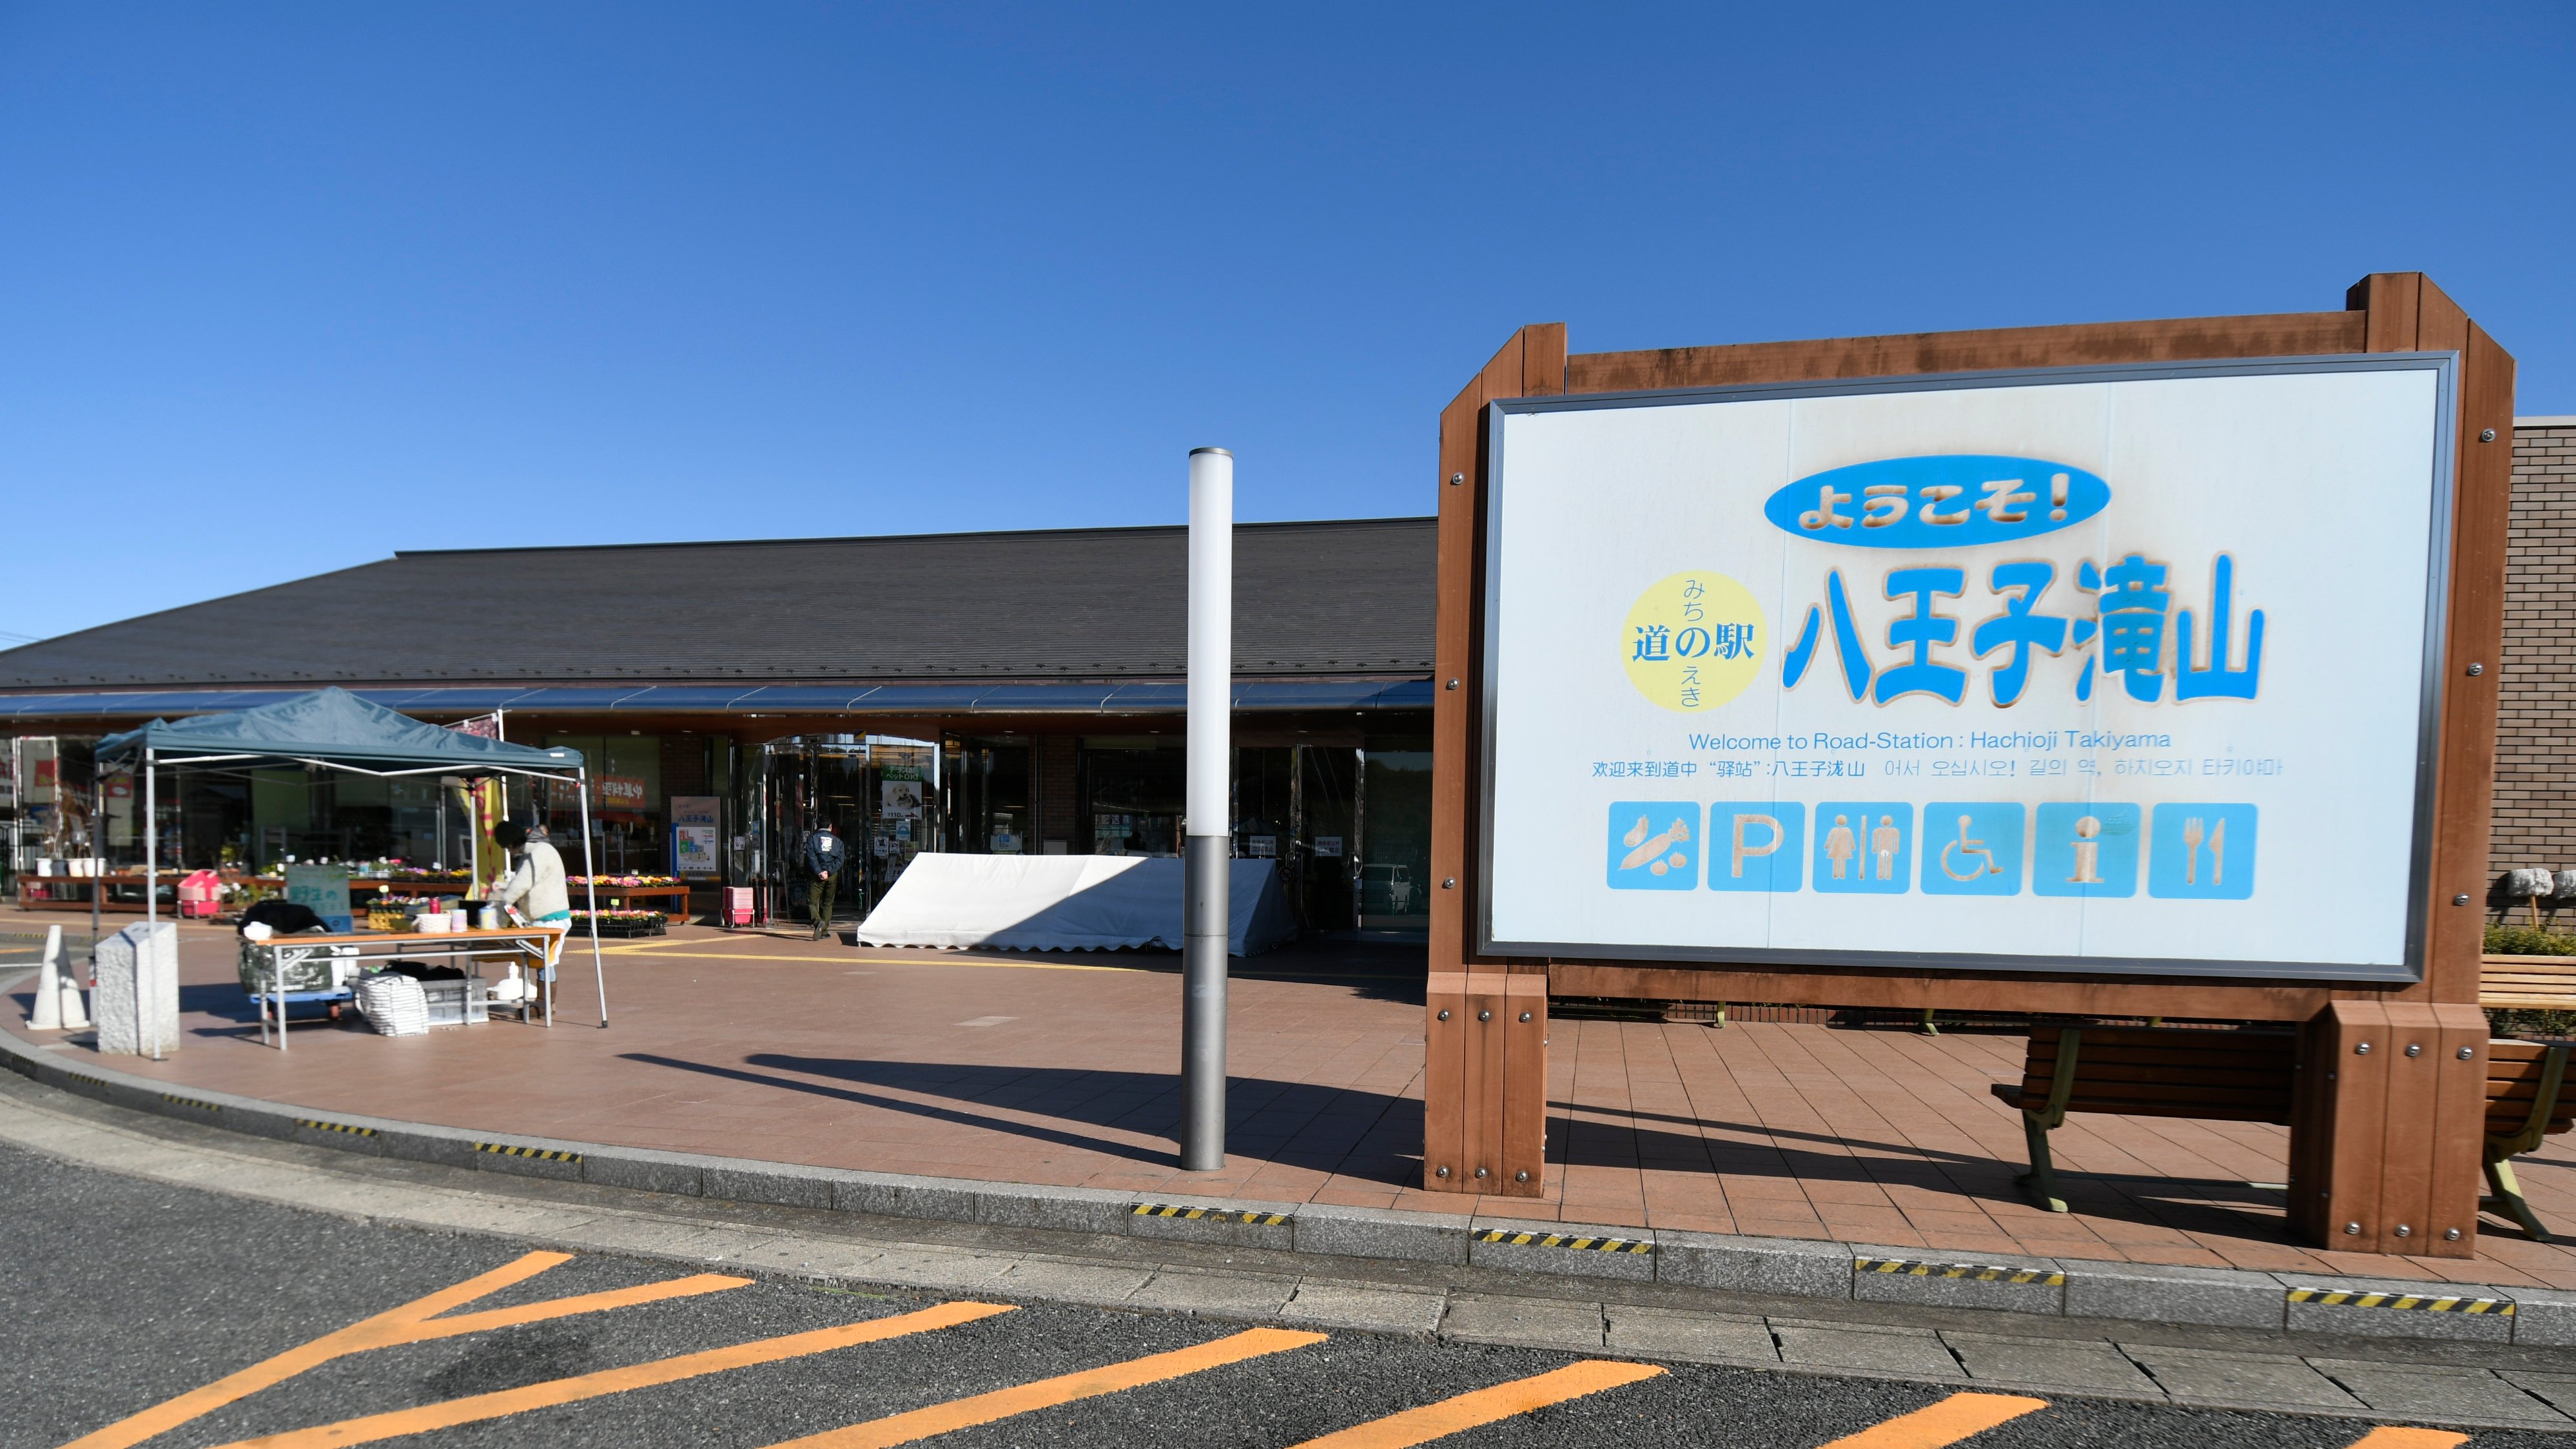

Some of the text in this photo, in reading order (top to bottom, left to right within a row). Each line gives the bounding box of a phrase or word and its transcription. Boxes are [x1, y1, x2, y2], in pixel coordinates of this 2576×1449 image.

[1799, 472, 2069, 530] ようこそ!
[1683, 579, 1705, 621] みち
[1632, 623, 1755, 662] 道の駅
[1782, 552, 2265, 707] 八王子滝山
[1681, 666, 1701, 707] えき
[1689, 733, 1781, 750] Welcome
[1788, 734, 1808, 750] to
[1814, 732, 1953, 750] Road-Station
[1971, 731, 2058, 751] Hachioji
[2064, 730, 2172, 750] Takiyama
[1885, 759, 1920, 776] 어서
[1931, 759, 2015, 777] 오십시오!
[2030, 759, 2067, 776] 길의
[2114, 759, 2192, 776] 하치오지
[2202, 759, 2283, 776] 타키야마
[1731, 813, 1784, 877] P
